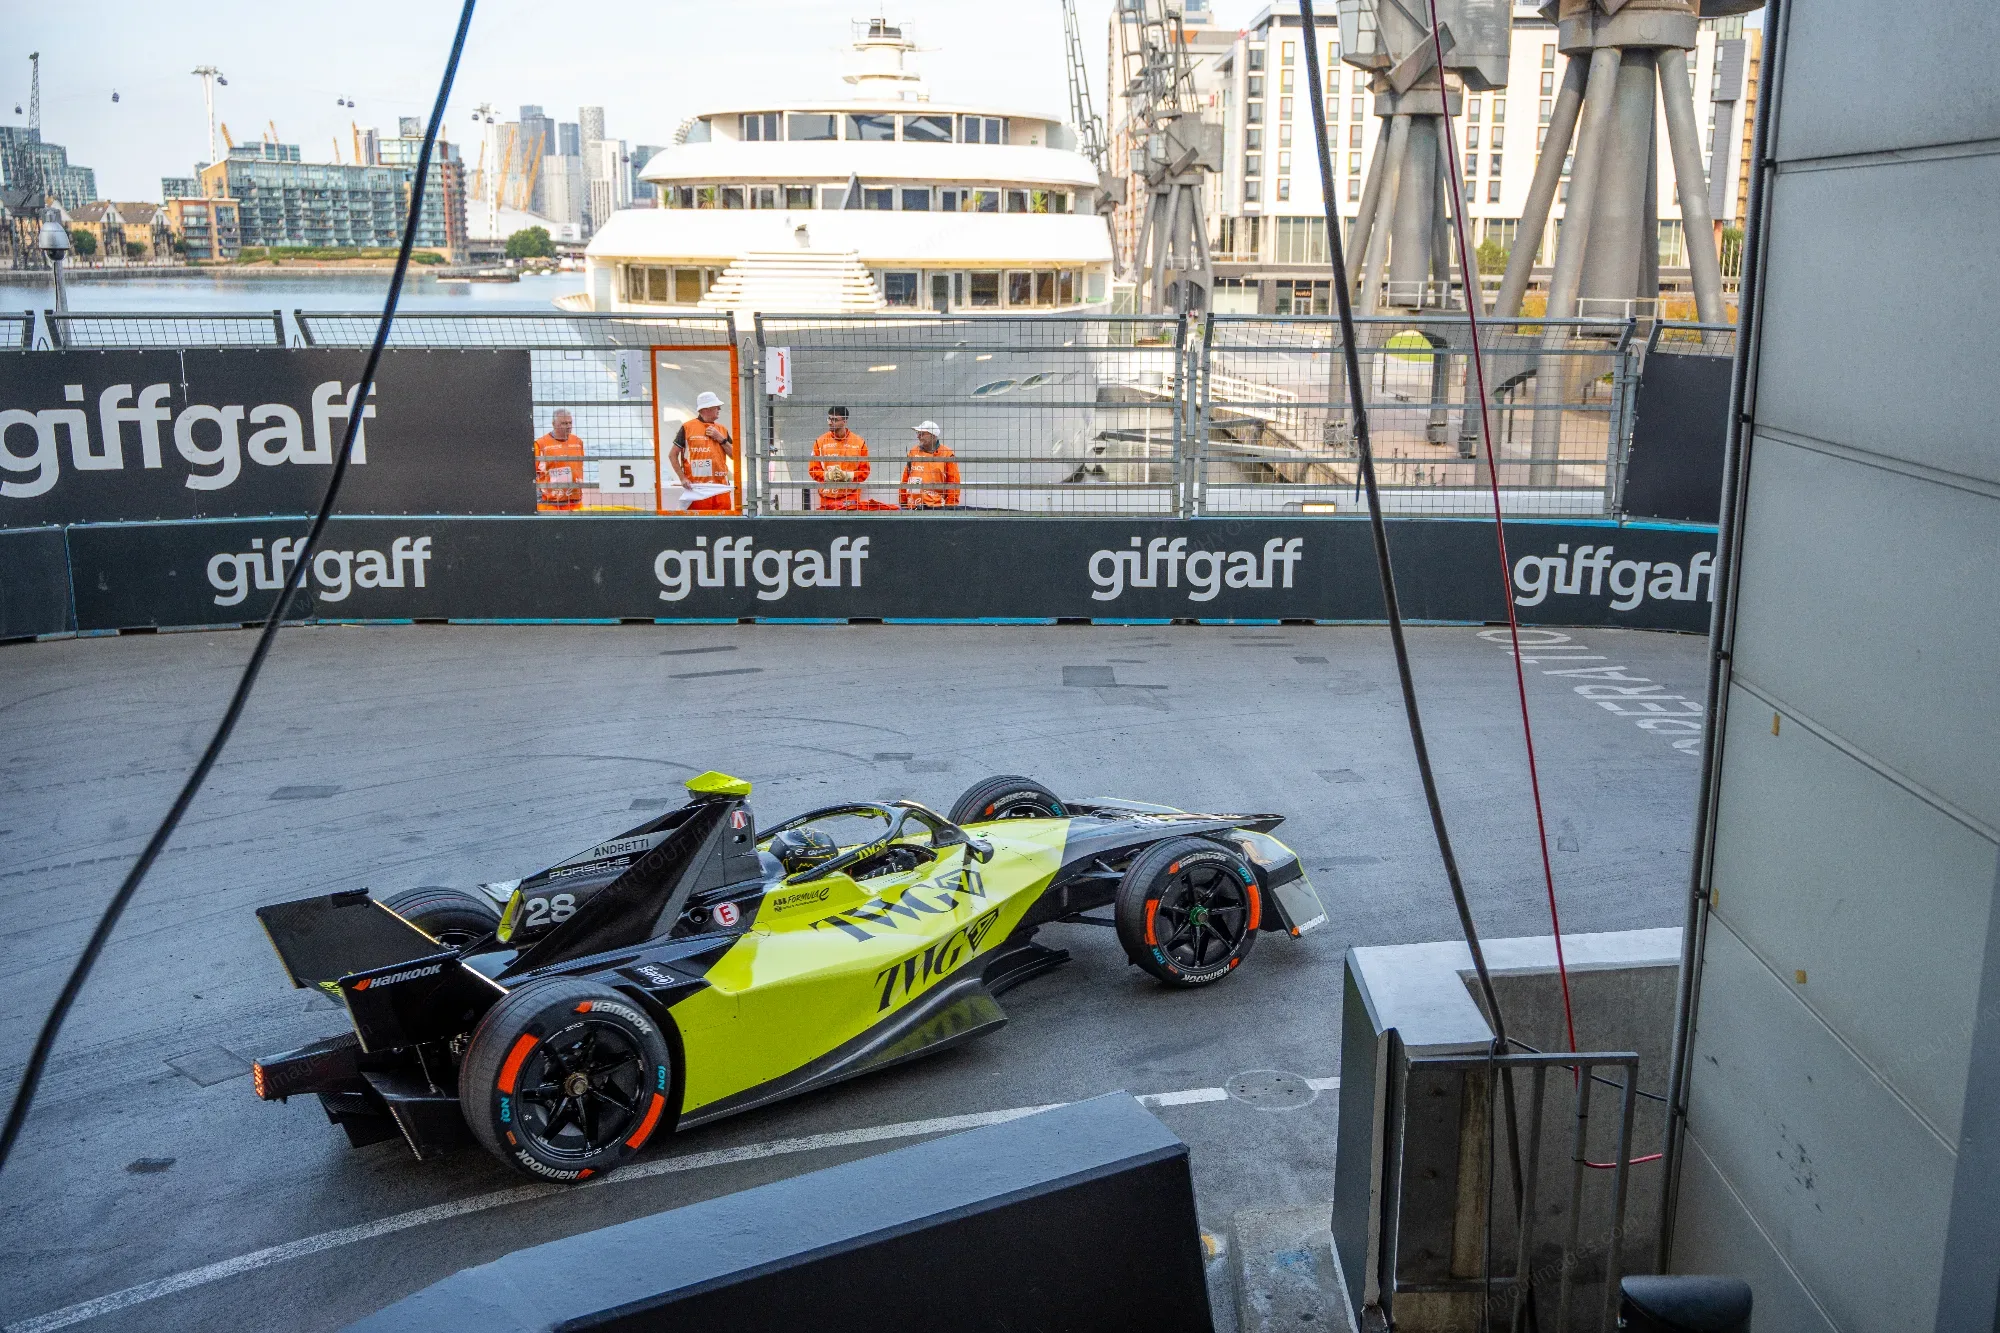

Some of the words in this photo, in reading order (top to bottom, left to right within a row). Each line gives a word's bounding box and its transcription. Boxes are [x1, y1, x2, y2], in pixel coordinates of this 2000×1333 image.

[0, 381, 377, 498] giffgaff
[619, 465, 635, 488] 5
[653, 536, 869, 602] giffgaff
[1088, 536, 1303, 602] giffgaff
[549, 856, 631, 880] PORSCHE
[593, 838, 650, 858] ANDRETTI
[525, 893, 577, 928] 28
[808, 883, 960, 943] TWG
[873, 926, 969, 1013] TWG
